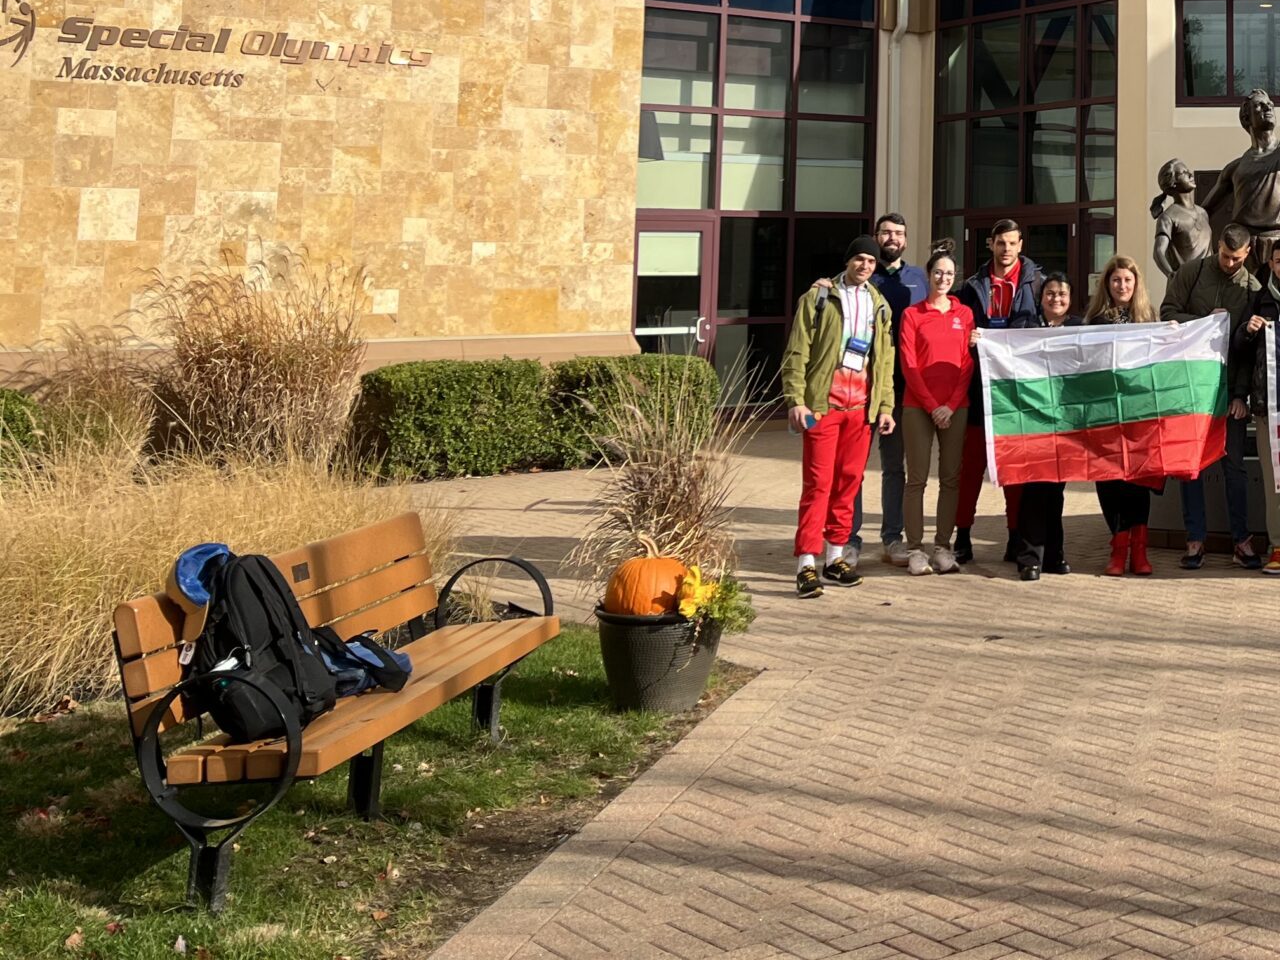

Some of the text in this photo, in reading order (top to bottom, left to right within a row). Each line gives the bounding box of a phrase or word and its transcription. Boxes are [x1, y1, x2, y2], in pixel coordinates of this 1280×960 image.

[58, 16, 434, 68] Special Olympics
[56, 56, 245, 88] Massachusetts
